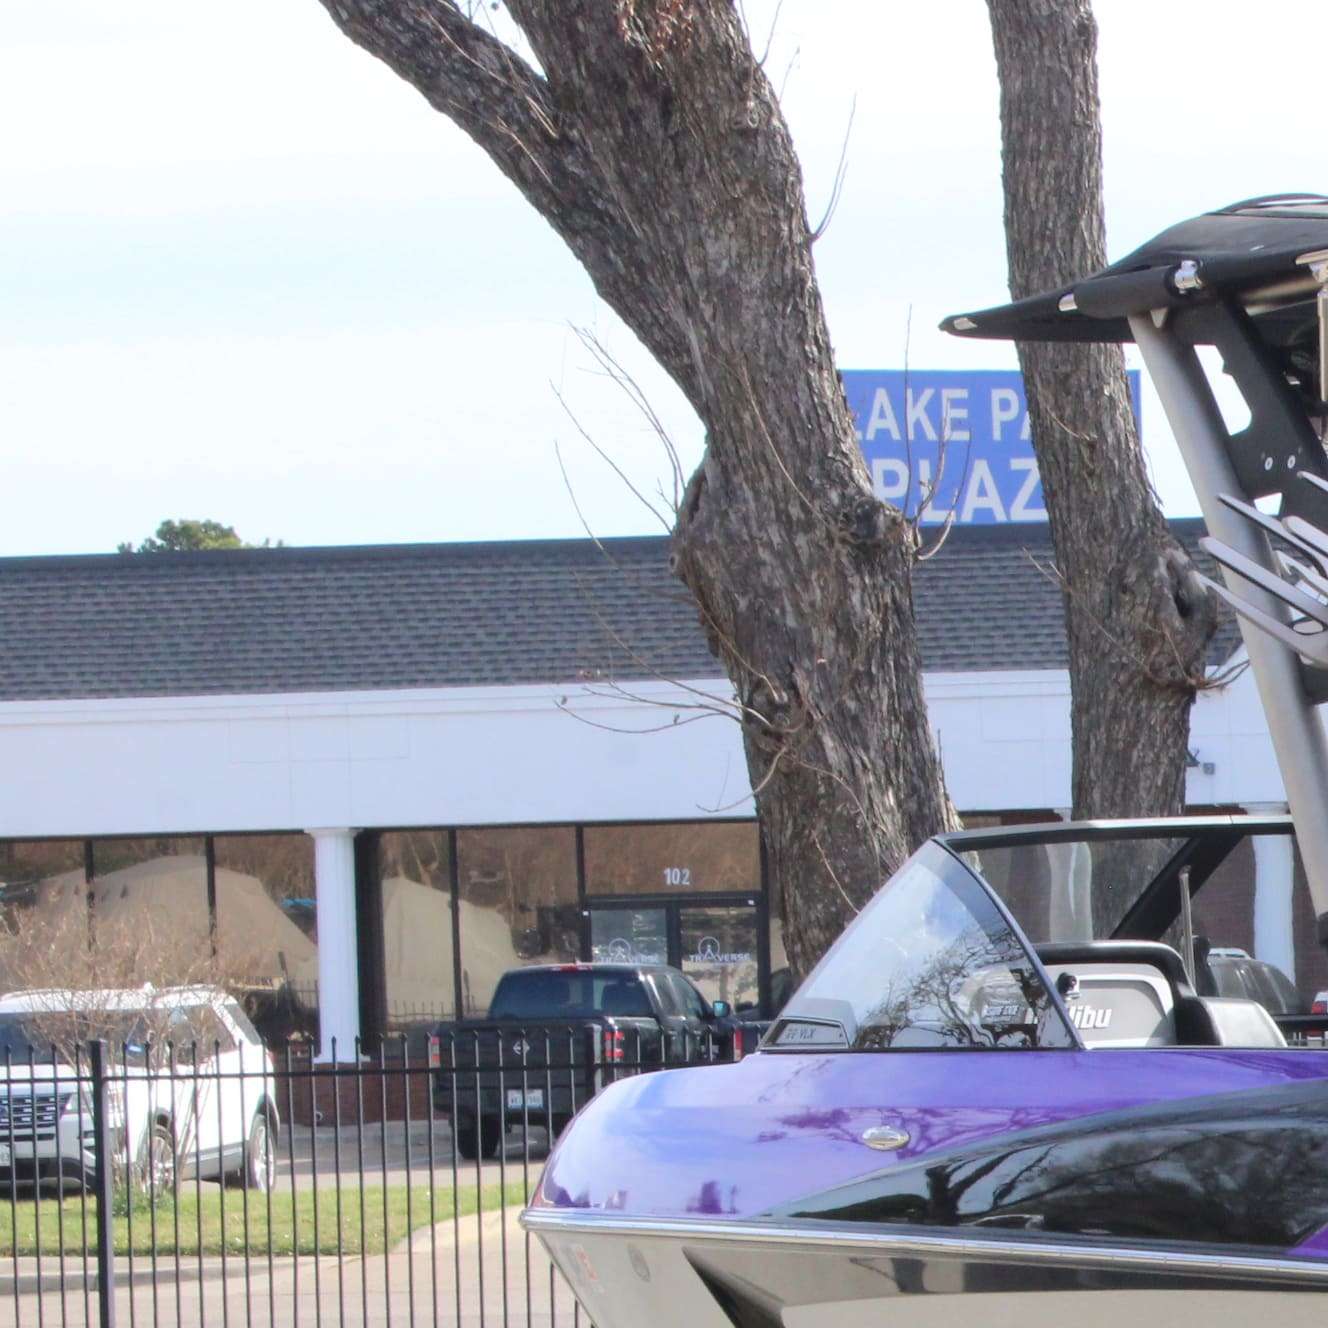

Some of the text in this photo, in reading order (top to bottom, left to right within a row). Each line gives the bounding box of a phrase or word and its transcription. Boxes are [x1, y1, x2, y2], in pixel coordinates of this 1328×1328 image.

[855, 386, 1031, 441] AKE P
[871, 457, 1049, 523] PLAZ
[664, 867, 691, 886] 102
